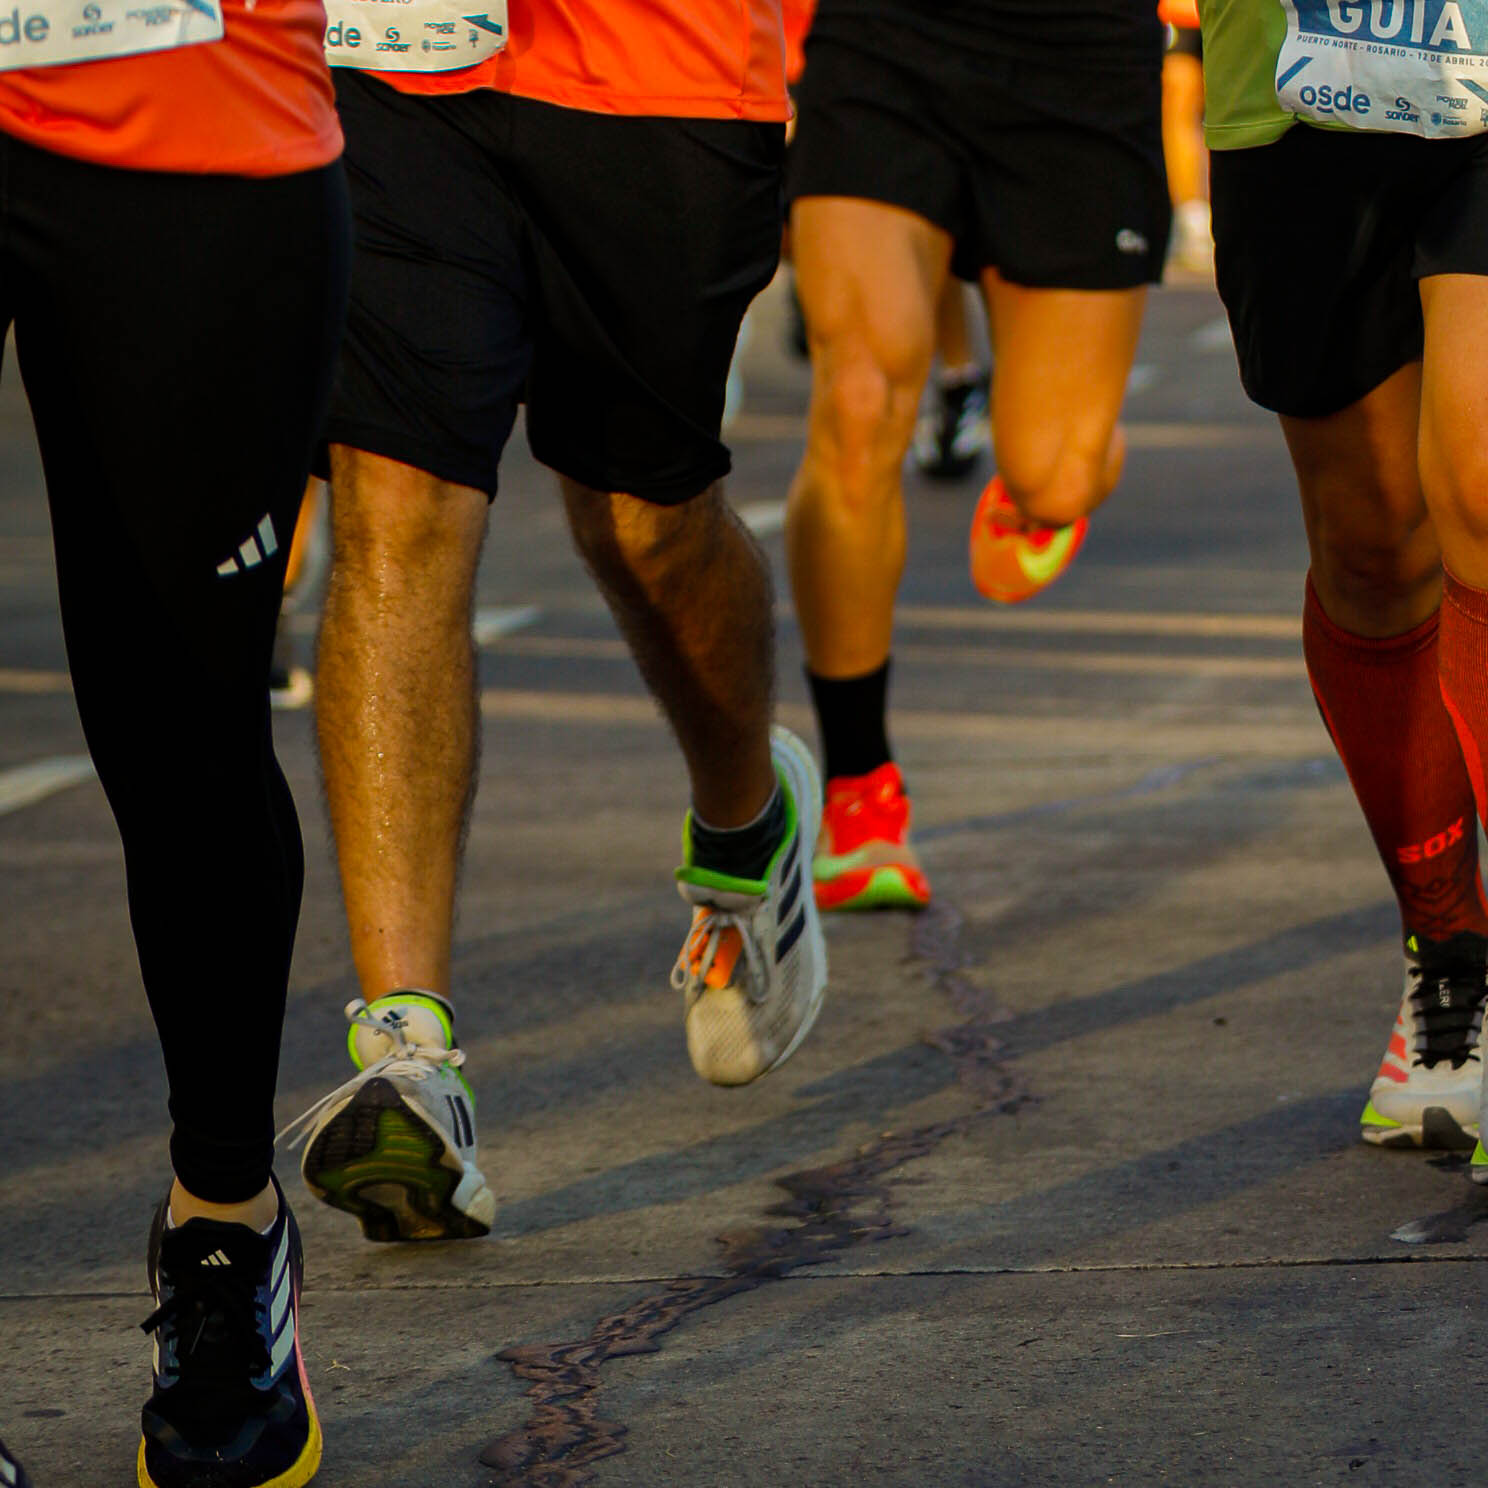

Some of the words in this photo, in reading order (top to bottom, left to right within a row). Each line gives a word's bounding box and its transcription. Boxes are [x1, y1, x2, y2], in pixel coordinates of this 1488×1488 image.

[0, 8, 49, 45] de
[1297, 34, 1329, 46] PUERTO
[1332, 40, 1358, 51] NORTE
[1366, 45, 1406, 57] ROSARIO
[1417, 52, 1428, 61] 12
[1430, 54, 1442, 63] DE
[1445, 56, 1475, 66] ABRIL
[1301, 84, 1371, 113] osde
[1397, 816, 1463, 863] SOX
